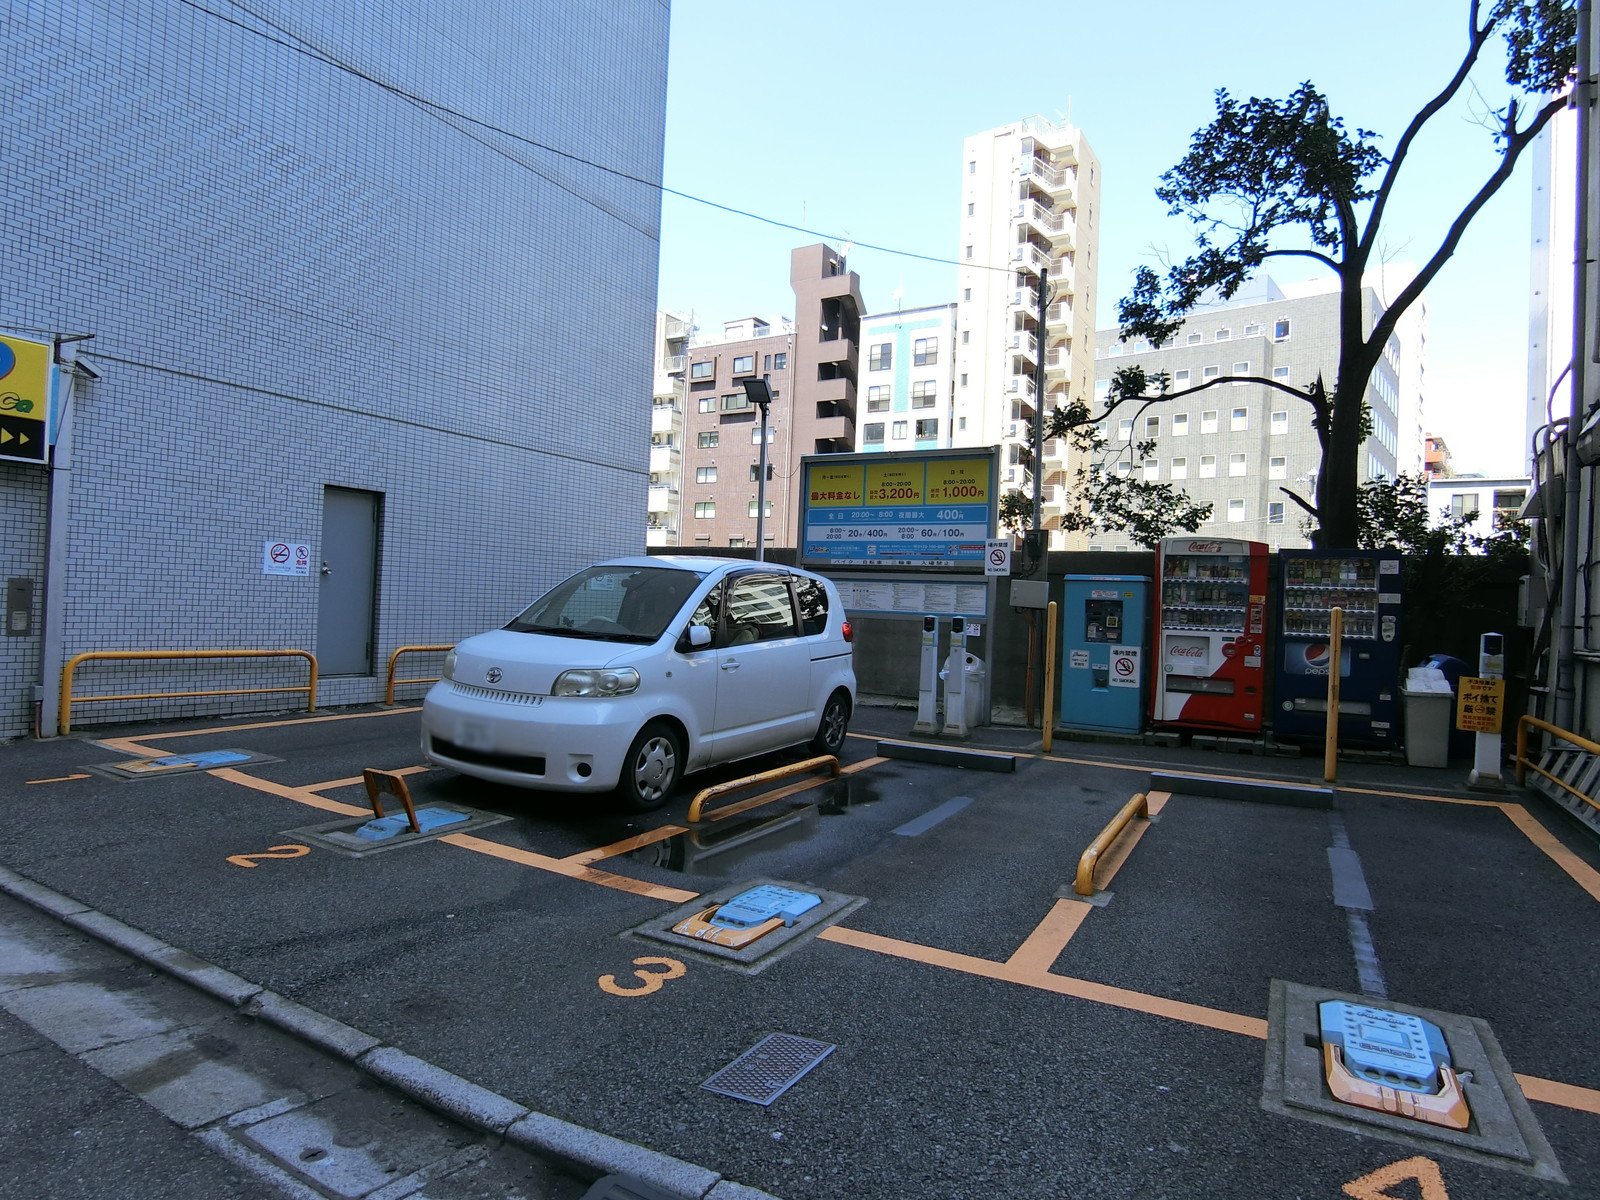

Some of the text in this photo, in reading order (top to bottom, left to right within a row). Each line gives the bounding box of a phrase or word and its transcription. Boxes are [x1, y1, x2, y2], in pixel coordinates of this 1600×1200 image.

[811, 491, 860, 501] 最大料金なし
[879, 488, 920, 500] 3,200円
[943, 486, 985, 498] 1,000円
[936, 509, 964, 521] 400円
[1188, 541, 1222, 553] Coca-Cola
[1170, 645, 1204, 657] Coca-Cola
[1305, 667, 1329, 675] peps
[1463, 693, 1498, 704] ポイ捨て
[225, 843, 312, 868] 2
[598, 955, 687, 997] 3
